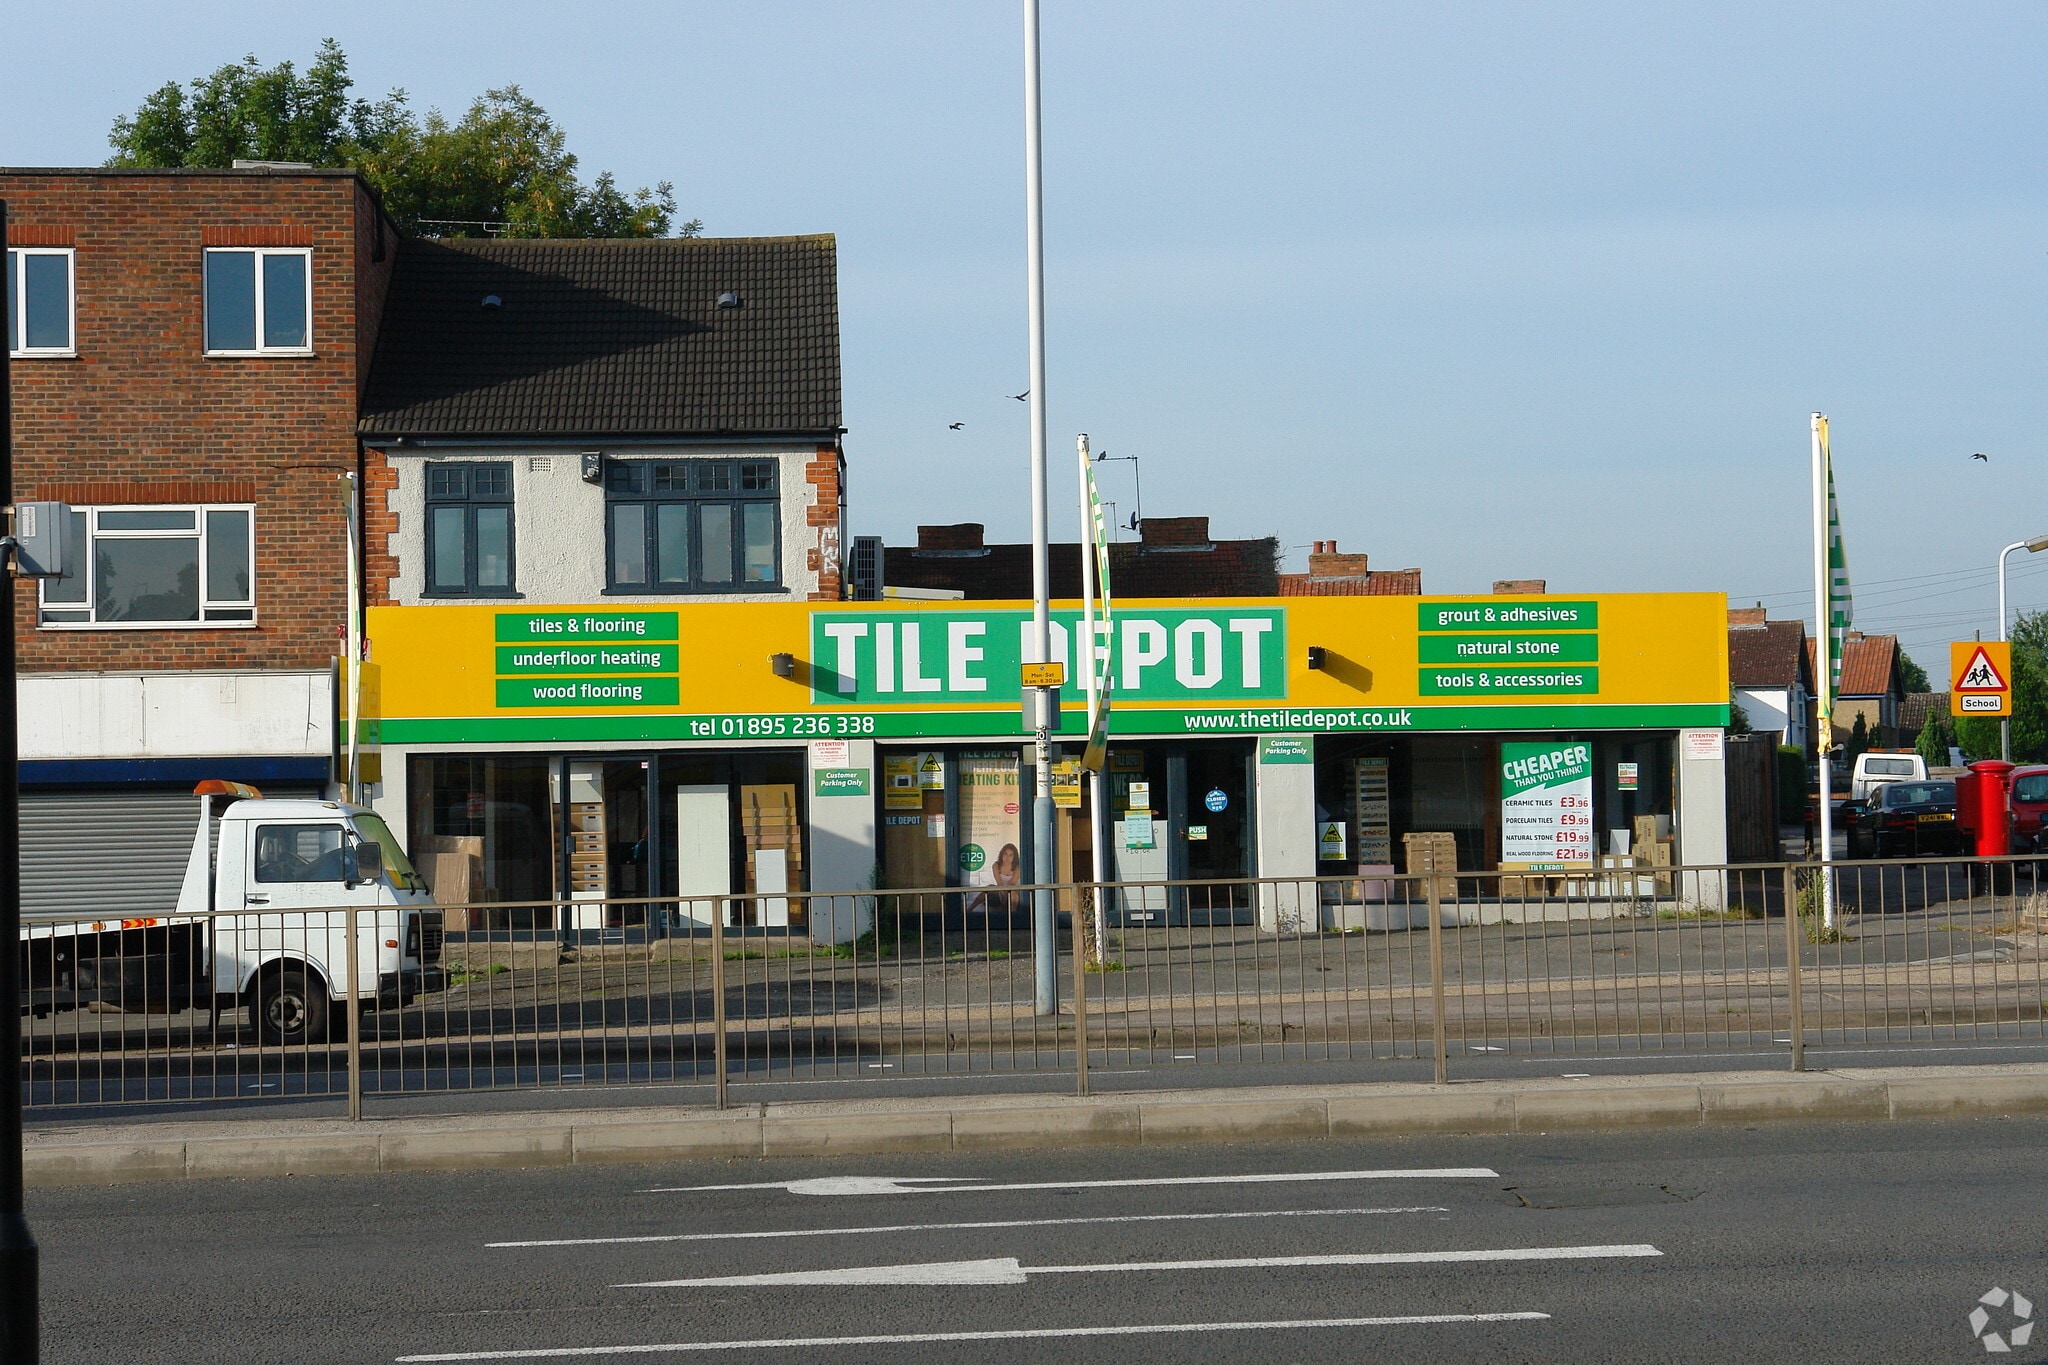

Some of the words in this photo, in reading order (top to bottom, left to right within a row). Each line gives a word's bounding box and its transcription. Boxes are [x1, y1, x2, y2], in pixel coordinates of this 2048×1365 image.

[1438, 608, 1481, 626] grout
[1484, 607, 1496, 622] &
[1500, 606, 1578, 622] adhesives
[528, 618, 563, 633] tiles
[567, 618, 580, 633] &
[583, 617, 646, 635] flooring
[1457, 640, 1512, 655] natural
[1516, 641, 1560, 655] stone
[513, 650, 597, 667] underfloor
[601, 650, 661, 668] heating
[824, 621, 987, 693] TILE
[1020, 618, 1273, 692] DEPOT
[1435, 672, 1474, 687] tools
[1478, 672, 1491, 687] &
[1494, 671, 1583, 687] accessories
[533, 683, 576, 699] wood
[580, 683, 643, 701] flooring
[1965, 699, 1998, 708] School
[690, 718, 716, 736] tel
[721, 717, 787, 736] 01895
[792, 716, 831, 734] 236
[836, 716, 875, 734] 338
[1184, 708, 1412, 731] www.thetiledepot.co.uk
[1265, 748, 1291, 756] Parking
[1291, 747, 1308, 755] Only
[1502, 745, 1589, 780] CHEAPER
[847, 779, 863, 787] Only
[1513, 776, 1537, 788] THAN
[1537, 771, 1555, 782] YOU
[1555, 765, 1583, 778] THINK!
[1560, 796, 1589, 808] £3.96
[898, 816, 921, 825] DEPOT
[1560, 814, 1589, 825] £9.99
[1188, 826, 1207, 834] PUSH
[1556, 831, 1590, 843] £19.99
[1556, 848, 1589, 860] £21.99
